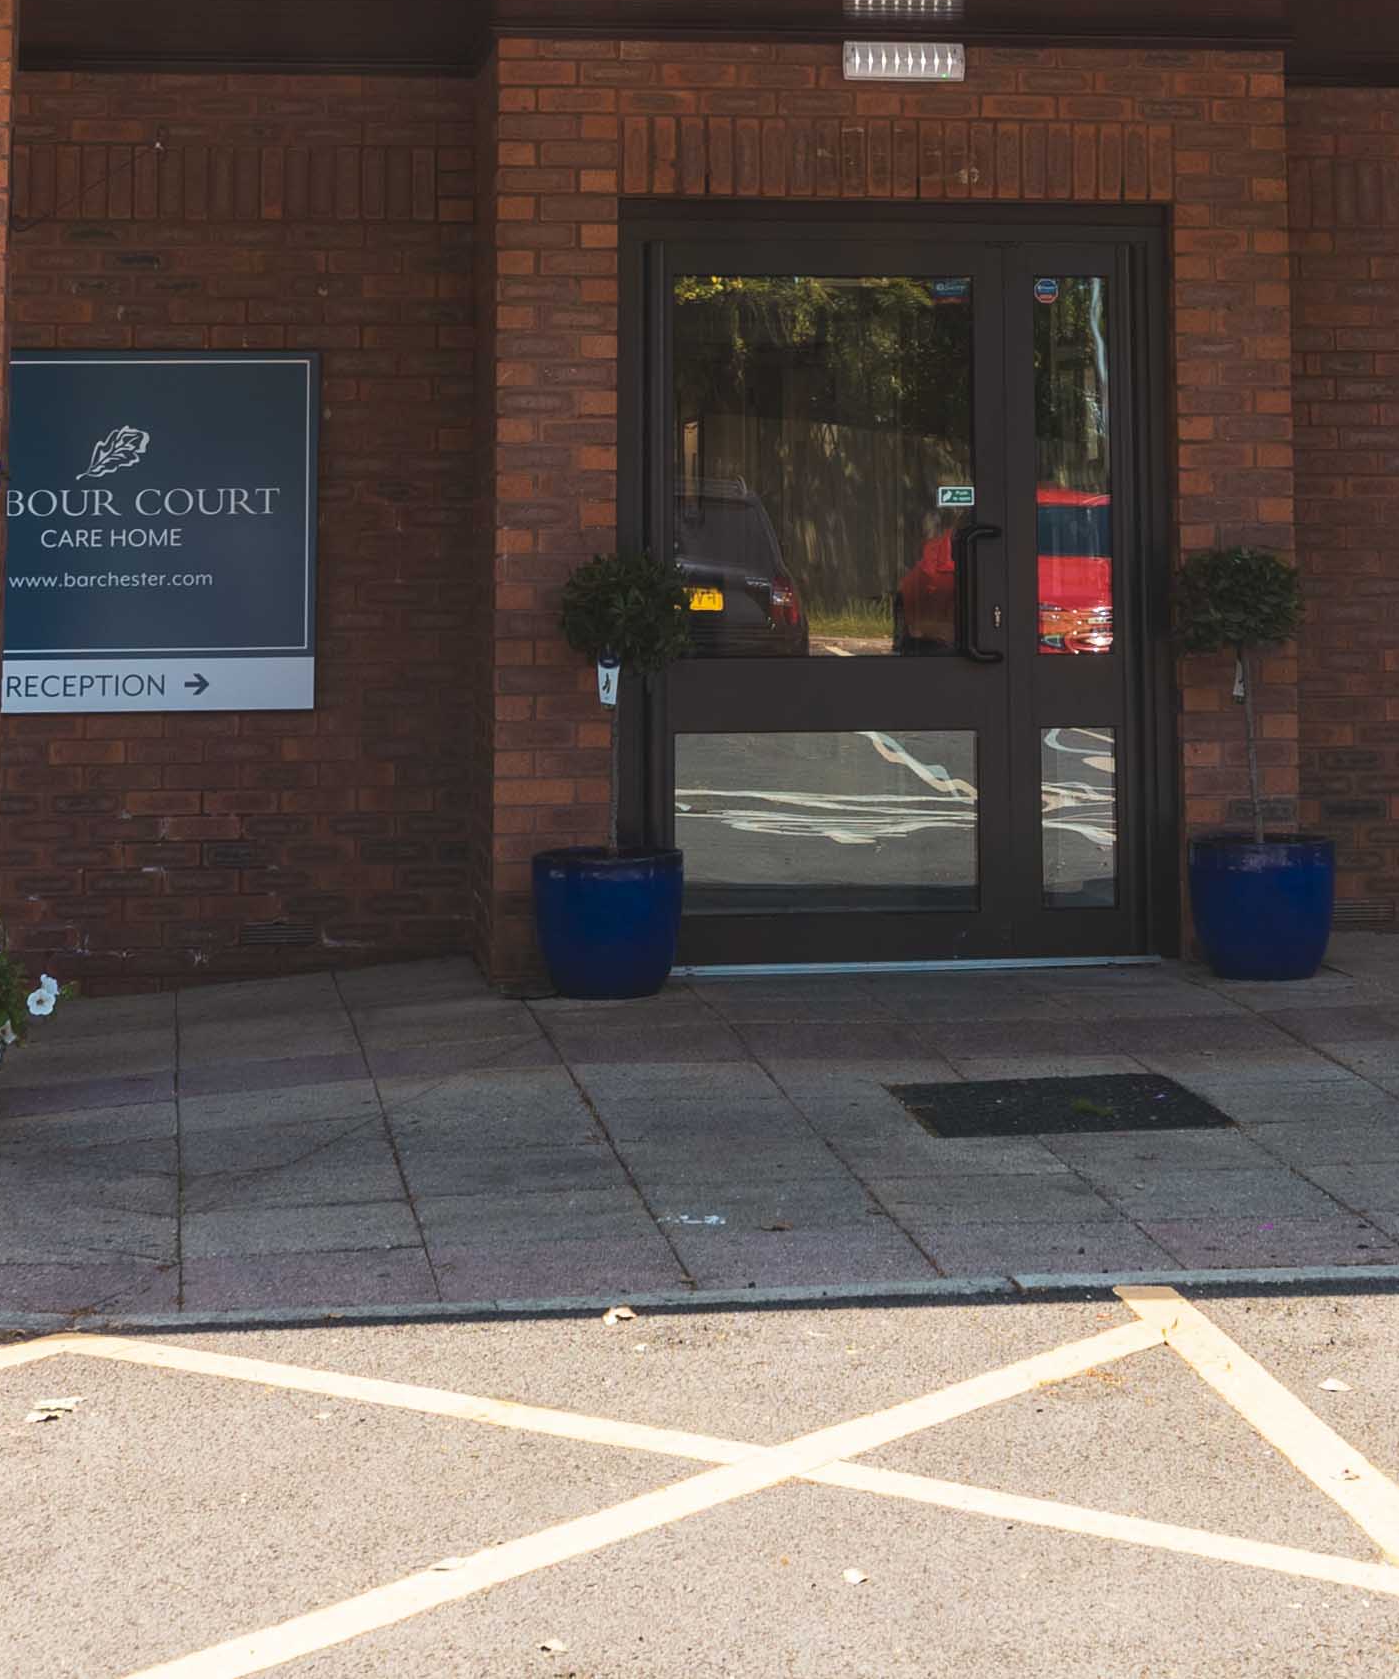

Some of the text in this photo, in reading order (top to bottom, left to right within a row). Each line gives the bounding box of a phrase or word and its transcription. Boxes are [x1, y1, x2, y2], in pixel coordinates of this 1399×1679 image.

[135, 487, 281, 516] COURT
[40, 527, 183, 549] CARE HOME
[8, 571, 214, 589] www.barchester.com
[5, 673, 165, 698] RECEPTION
